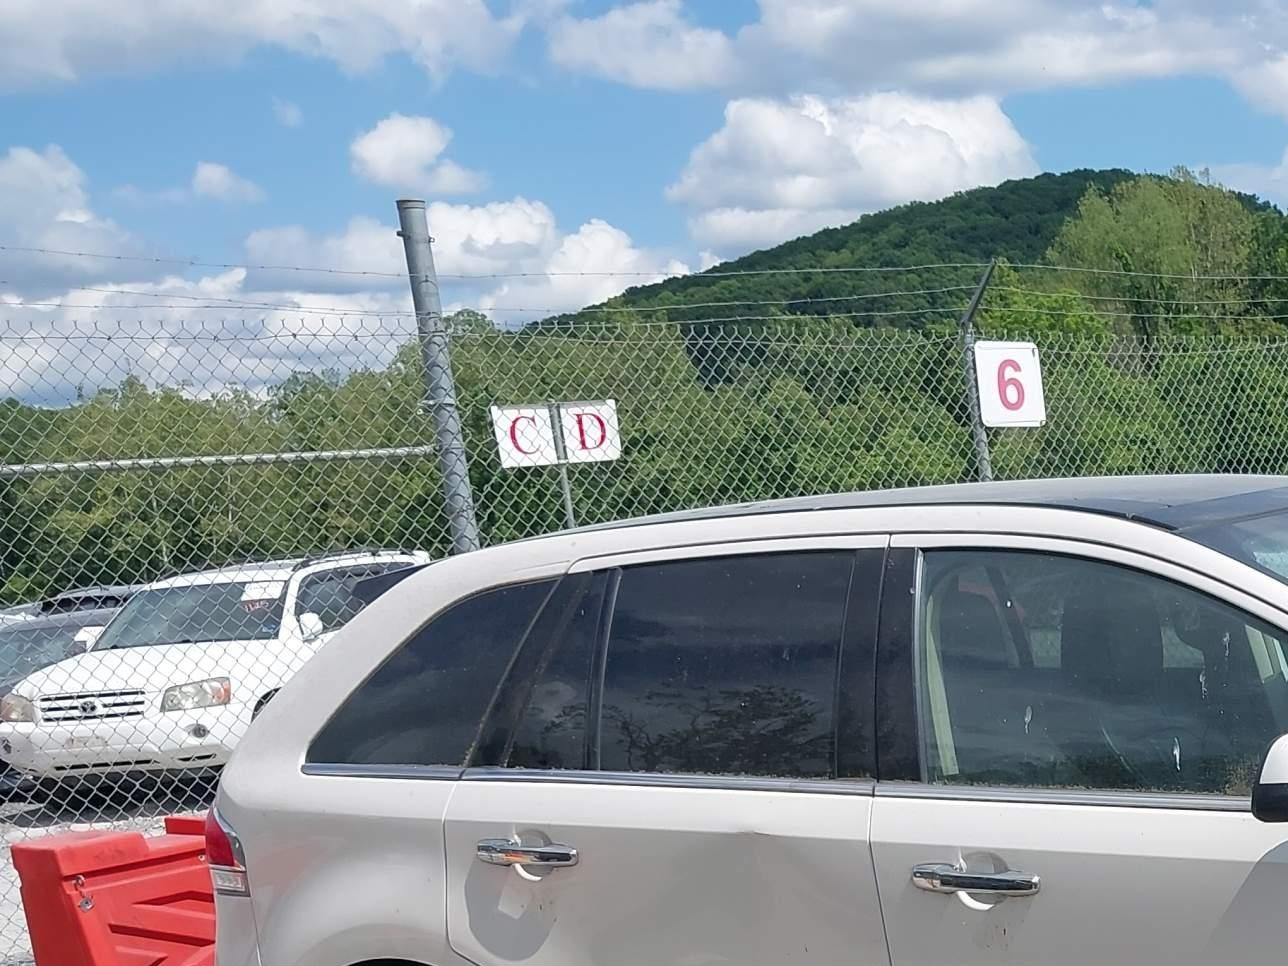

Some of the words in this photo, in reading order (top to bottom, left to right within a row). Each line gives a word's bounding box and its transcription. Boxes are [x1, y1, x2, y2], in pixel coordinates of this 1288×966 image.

[997, 359, 1025, 411] 6
[509, 415, 541, 455] C
[574, 412, 607, 451] D
